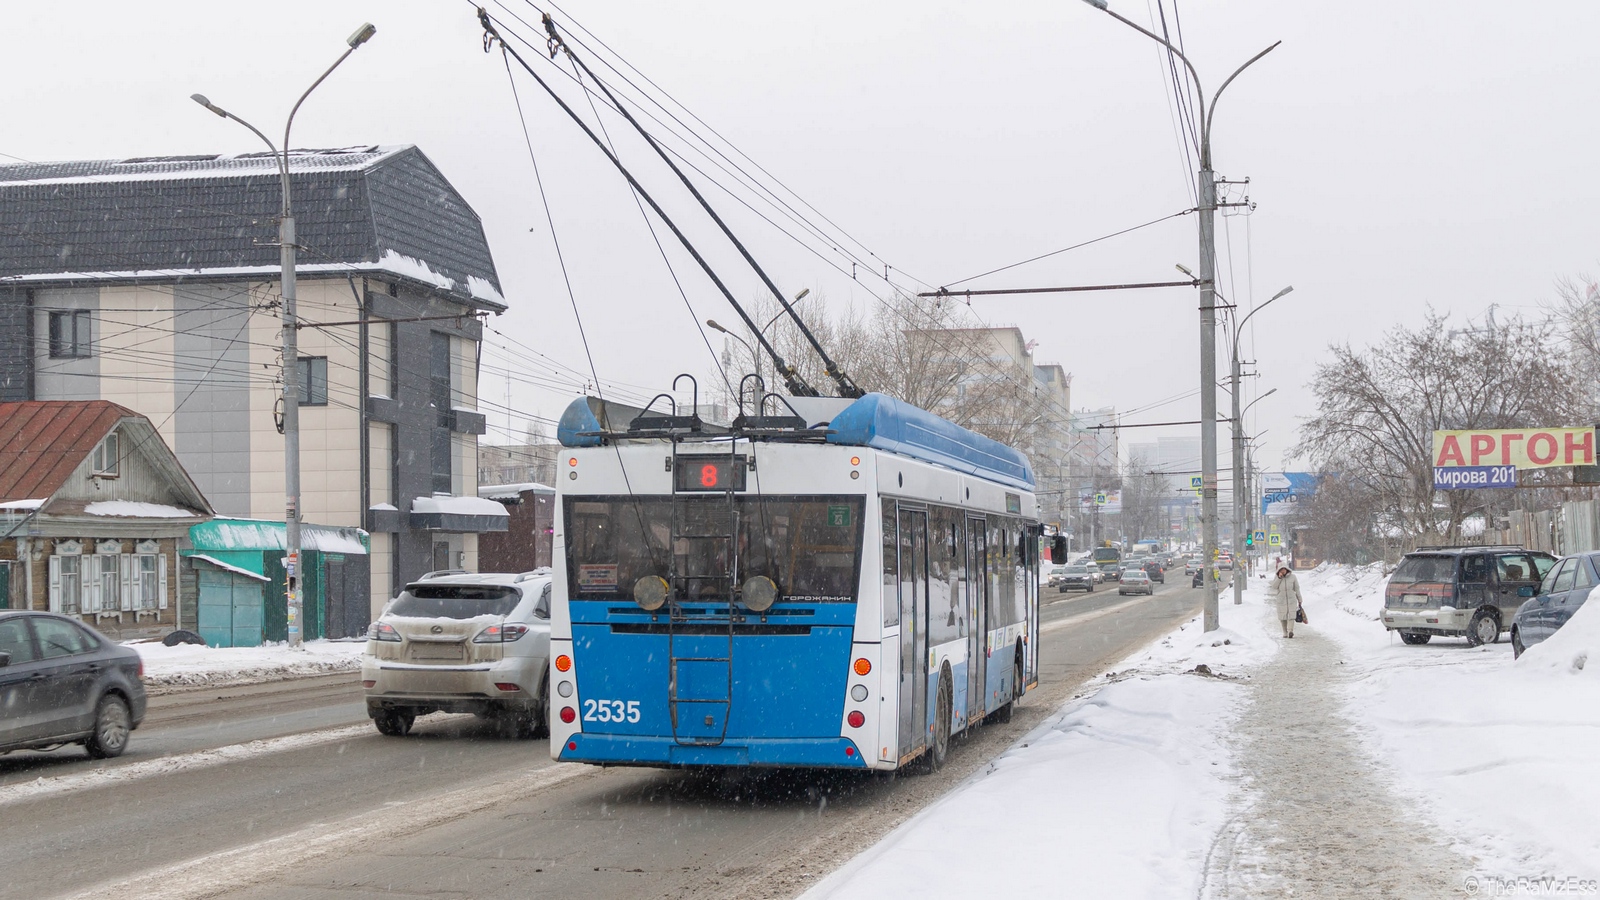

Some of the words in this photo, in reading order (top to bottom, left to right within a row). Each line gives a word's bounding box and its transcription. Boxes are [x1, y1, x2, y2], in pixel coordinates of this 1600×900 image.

[1436, 432, 1593, 467] АРГОН
[701, 465, 717, 487] 8
[1434, 467, 1487, 488] Кирова
[1491, 466, 1515, 483] 201
[583, 698, 641, 724] 2535
